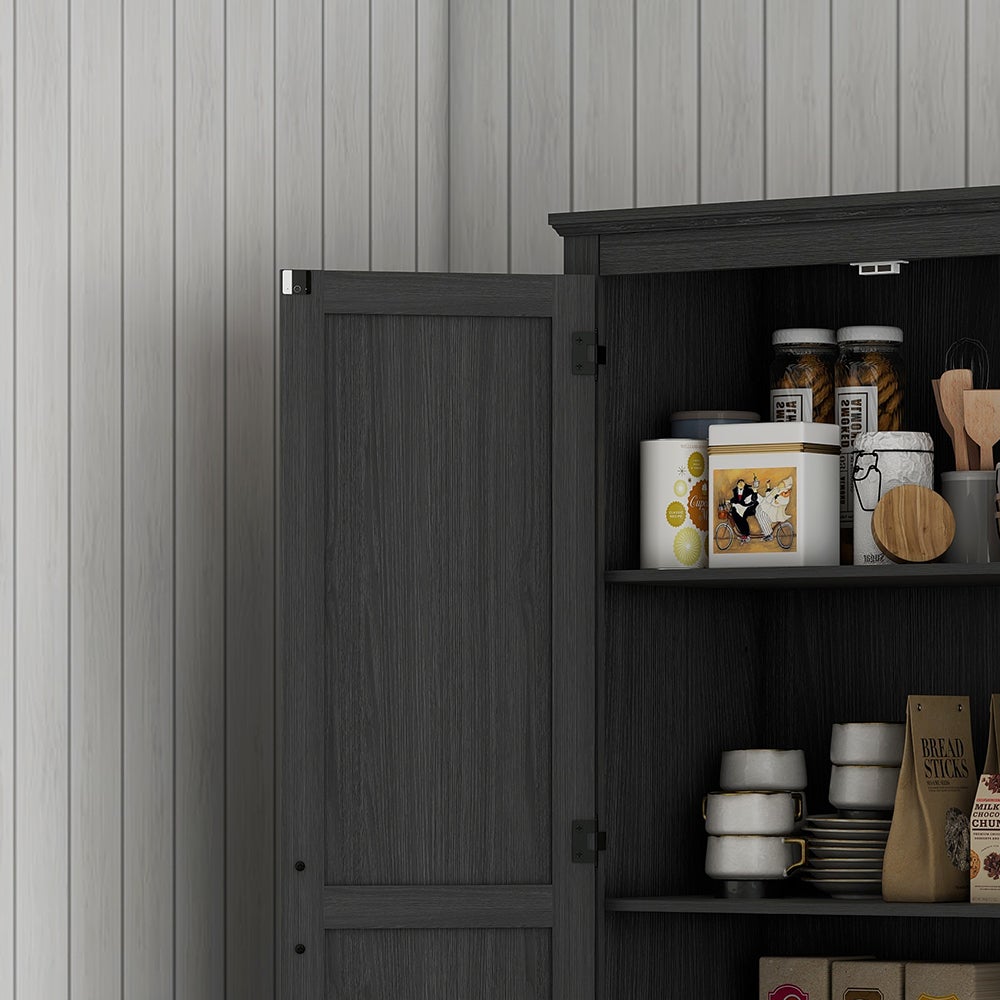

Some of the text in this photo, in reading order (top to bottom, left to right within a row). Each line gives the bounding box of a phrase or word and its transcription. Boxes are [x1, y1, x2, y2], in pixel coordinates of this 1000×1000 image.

[921, 737, 964, 758] BREAD
[924, 758, 969, 778] STICKS
[974, 803, 1000, 811] MILK
